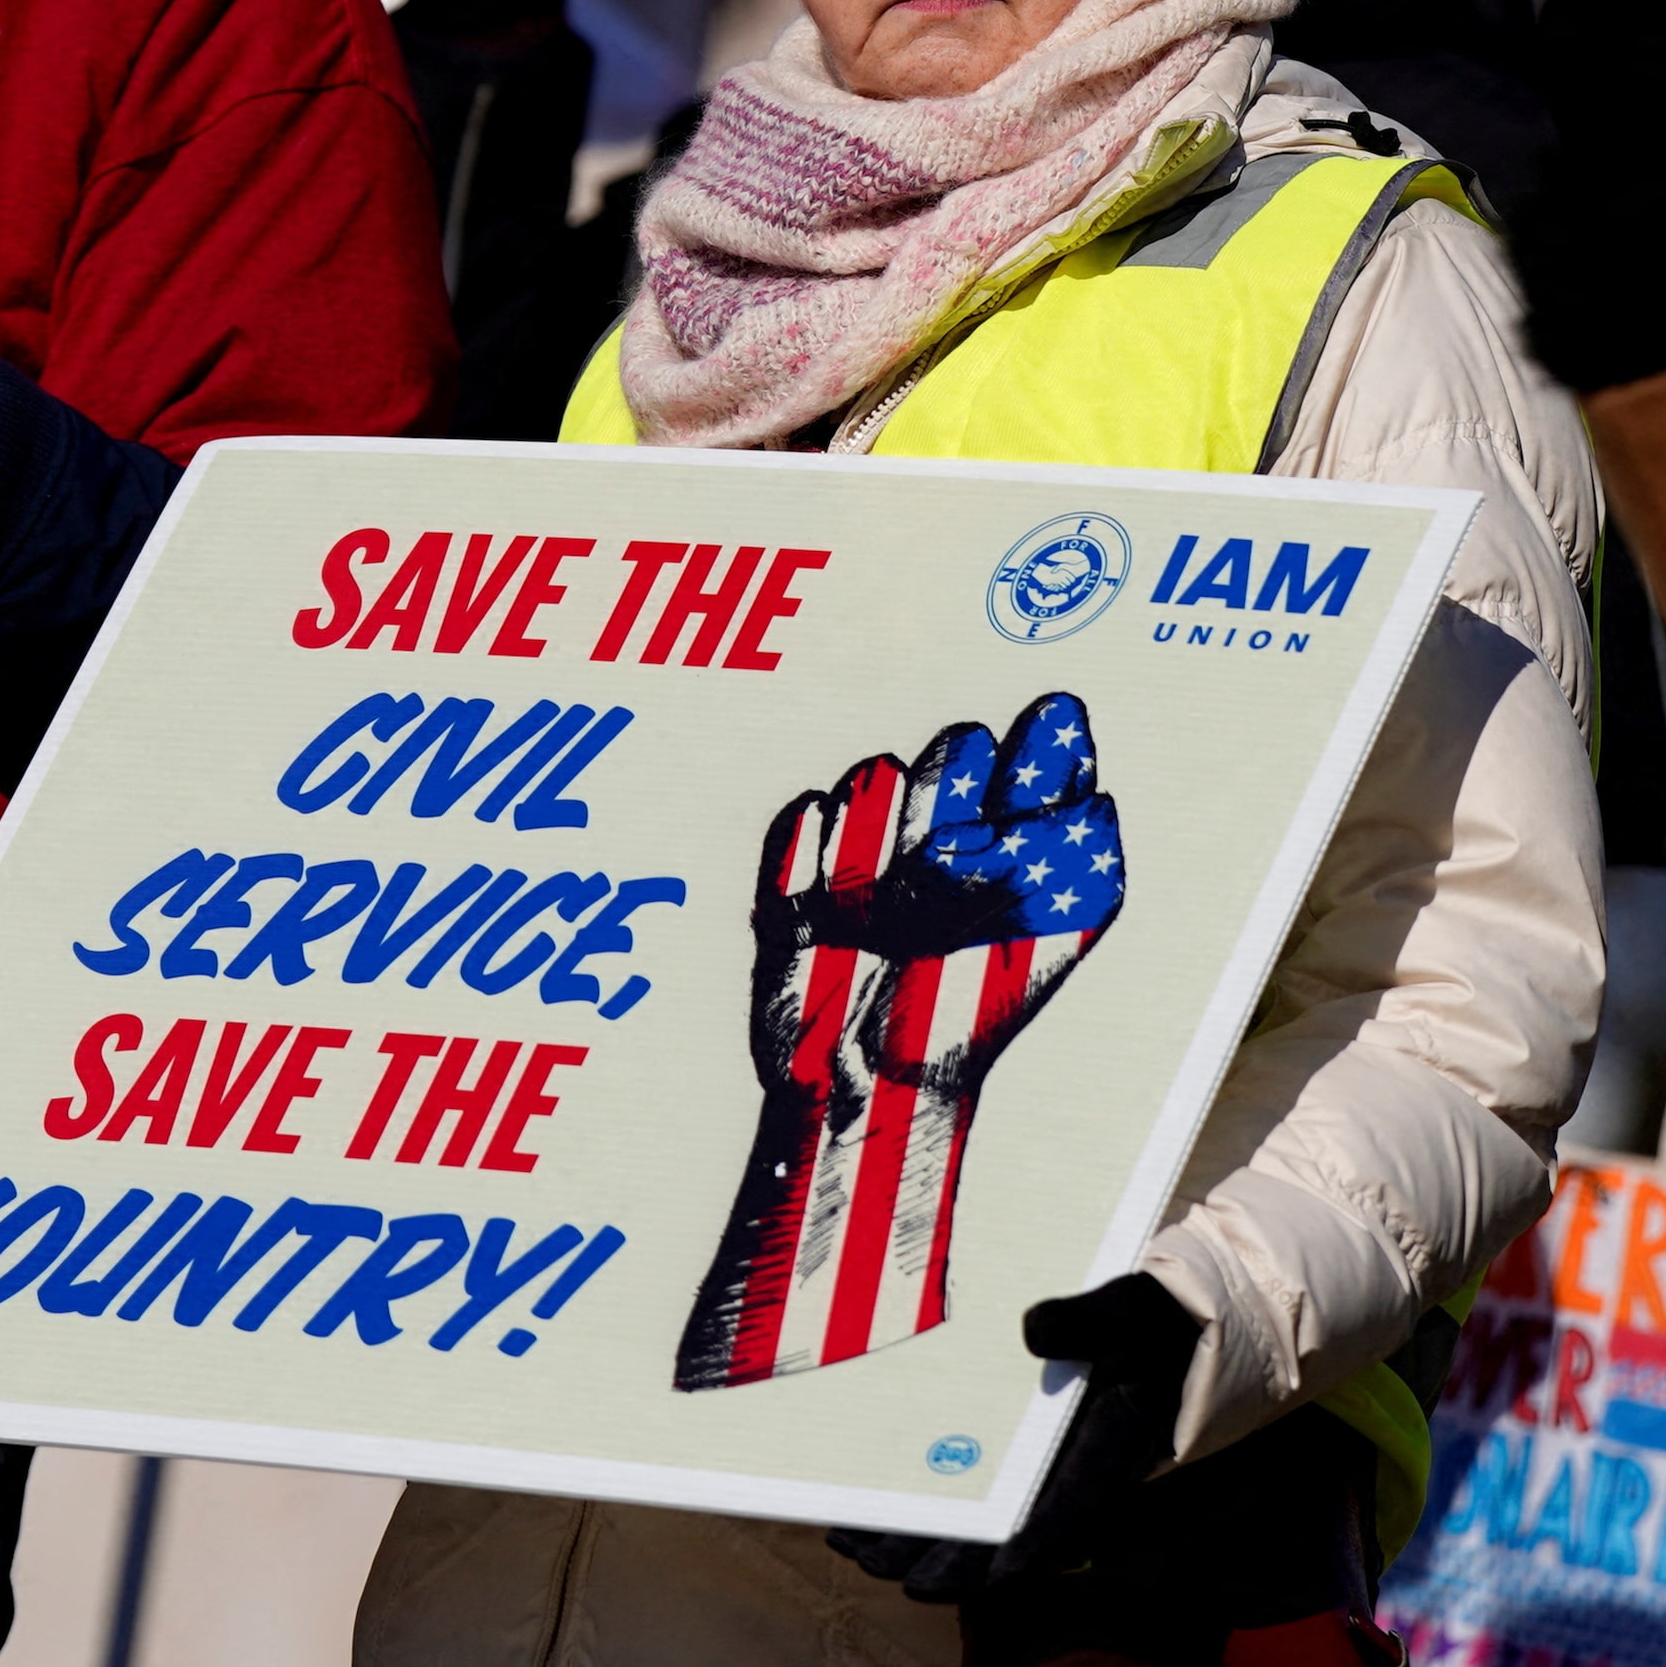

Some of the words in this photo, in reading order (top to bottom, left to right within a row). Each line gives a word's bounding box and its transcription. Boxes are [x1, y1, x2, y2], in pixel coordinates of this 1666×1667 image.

[291, 527, 596, 659] SAVE
[588, 537, 832, 672] THE
[1060, 539, 1090, 552] FOR
[1149, 534, 1371, 618] IAM
[1152, 622, 1310, 654] UNION
[276, 692, 636, 832] CIVIL
[72, 847, 688, 1021] SERVICE,
[43, 1012, 353, 1160] SAVE
[345, 1028, 590, 1174] THE
